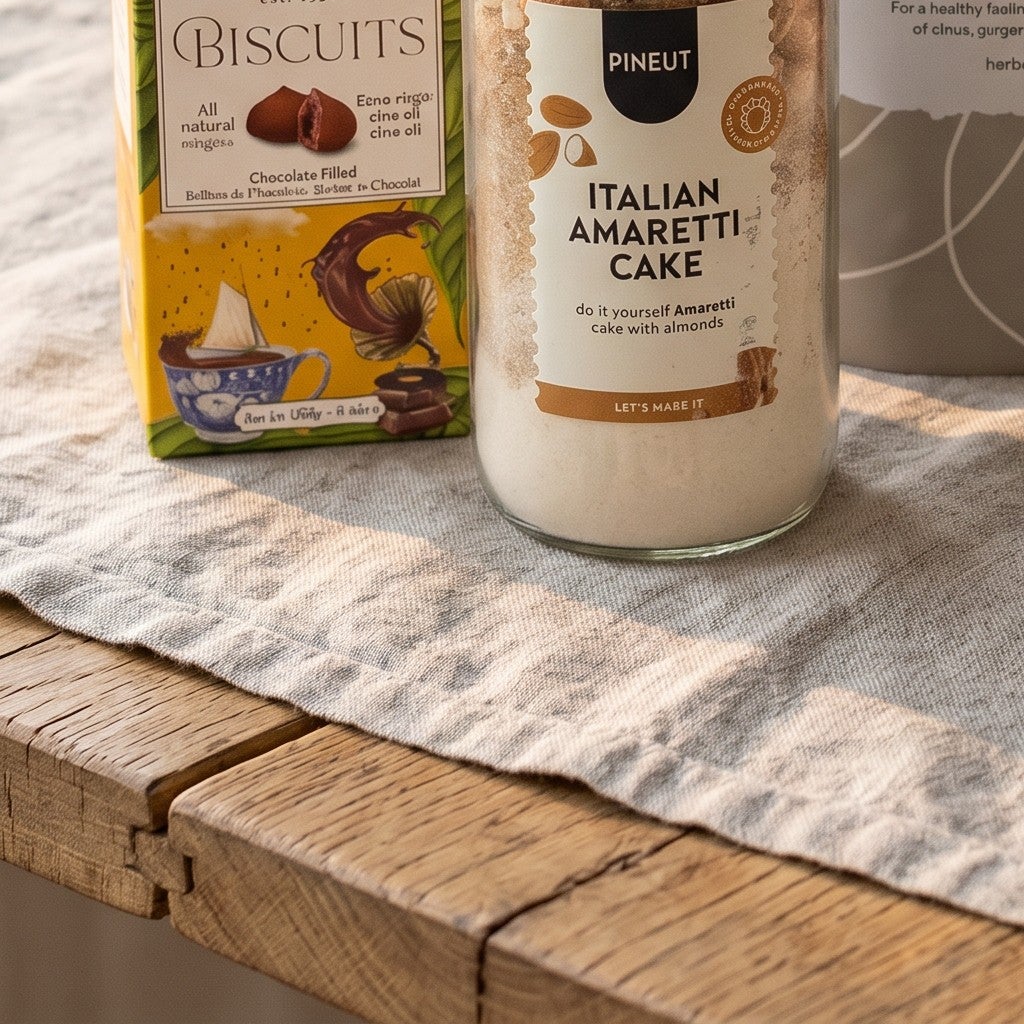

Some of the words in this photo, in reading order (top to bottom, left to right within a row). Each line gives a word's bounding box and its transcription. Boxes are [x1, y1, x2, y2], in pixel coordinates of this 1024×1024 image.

[891, 1, 915, 14] For
[918, 4, 926, 14] a
[930, 2, 982, 18] healthy
[913, 23, 929, 35] of
[977, 26, 1024, 39] gurger
[609, 50, 691, 72] PINEUT
[198, 102, 218, 117] All
[369, 109, 400, 123] cine
[403, 106, 420, 120] oli
[181, 117, 235, 133] natural
[370, 125, 401, 139] cine
[404, 122, 422, 136] oli
[249, 169, 318, 184] Chocolate
[321, 165, 357, 180] Filled
[588, 178, 720, 211] ITALIAN
[568, 209, 740, 247] AMARETTI
[609, 249, 703, 281] CAKE
[576, 303, 595, 317] do
[599, 304, 608, 317] it
[612, 302, 671, 322] yourself
[674, 297, 736, 317] Amaretti
[591, 321, 624, 335] cake
[627, 320, 660, 335] with
[664, 316, 724, 333] almonds
[614, 402, 649, 413] LET'S
[692, 398, 705, 409] IT
